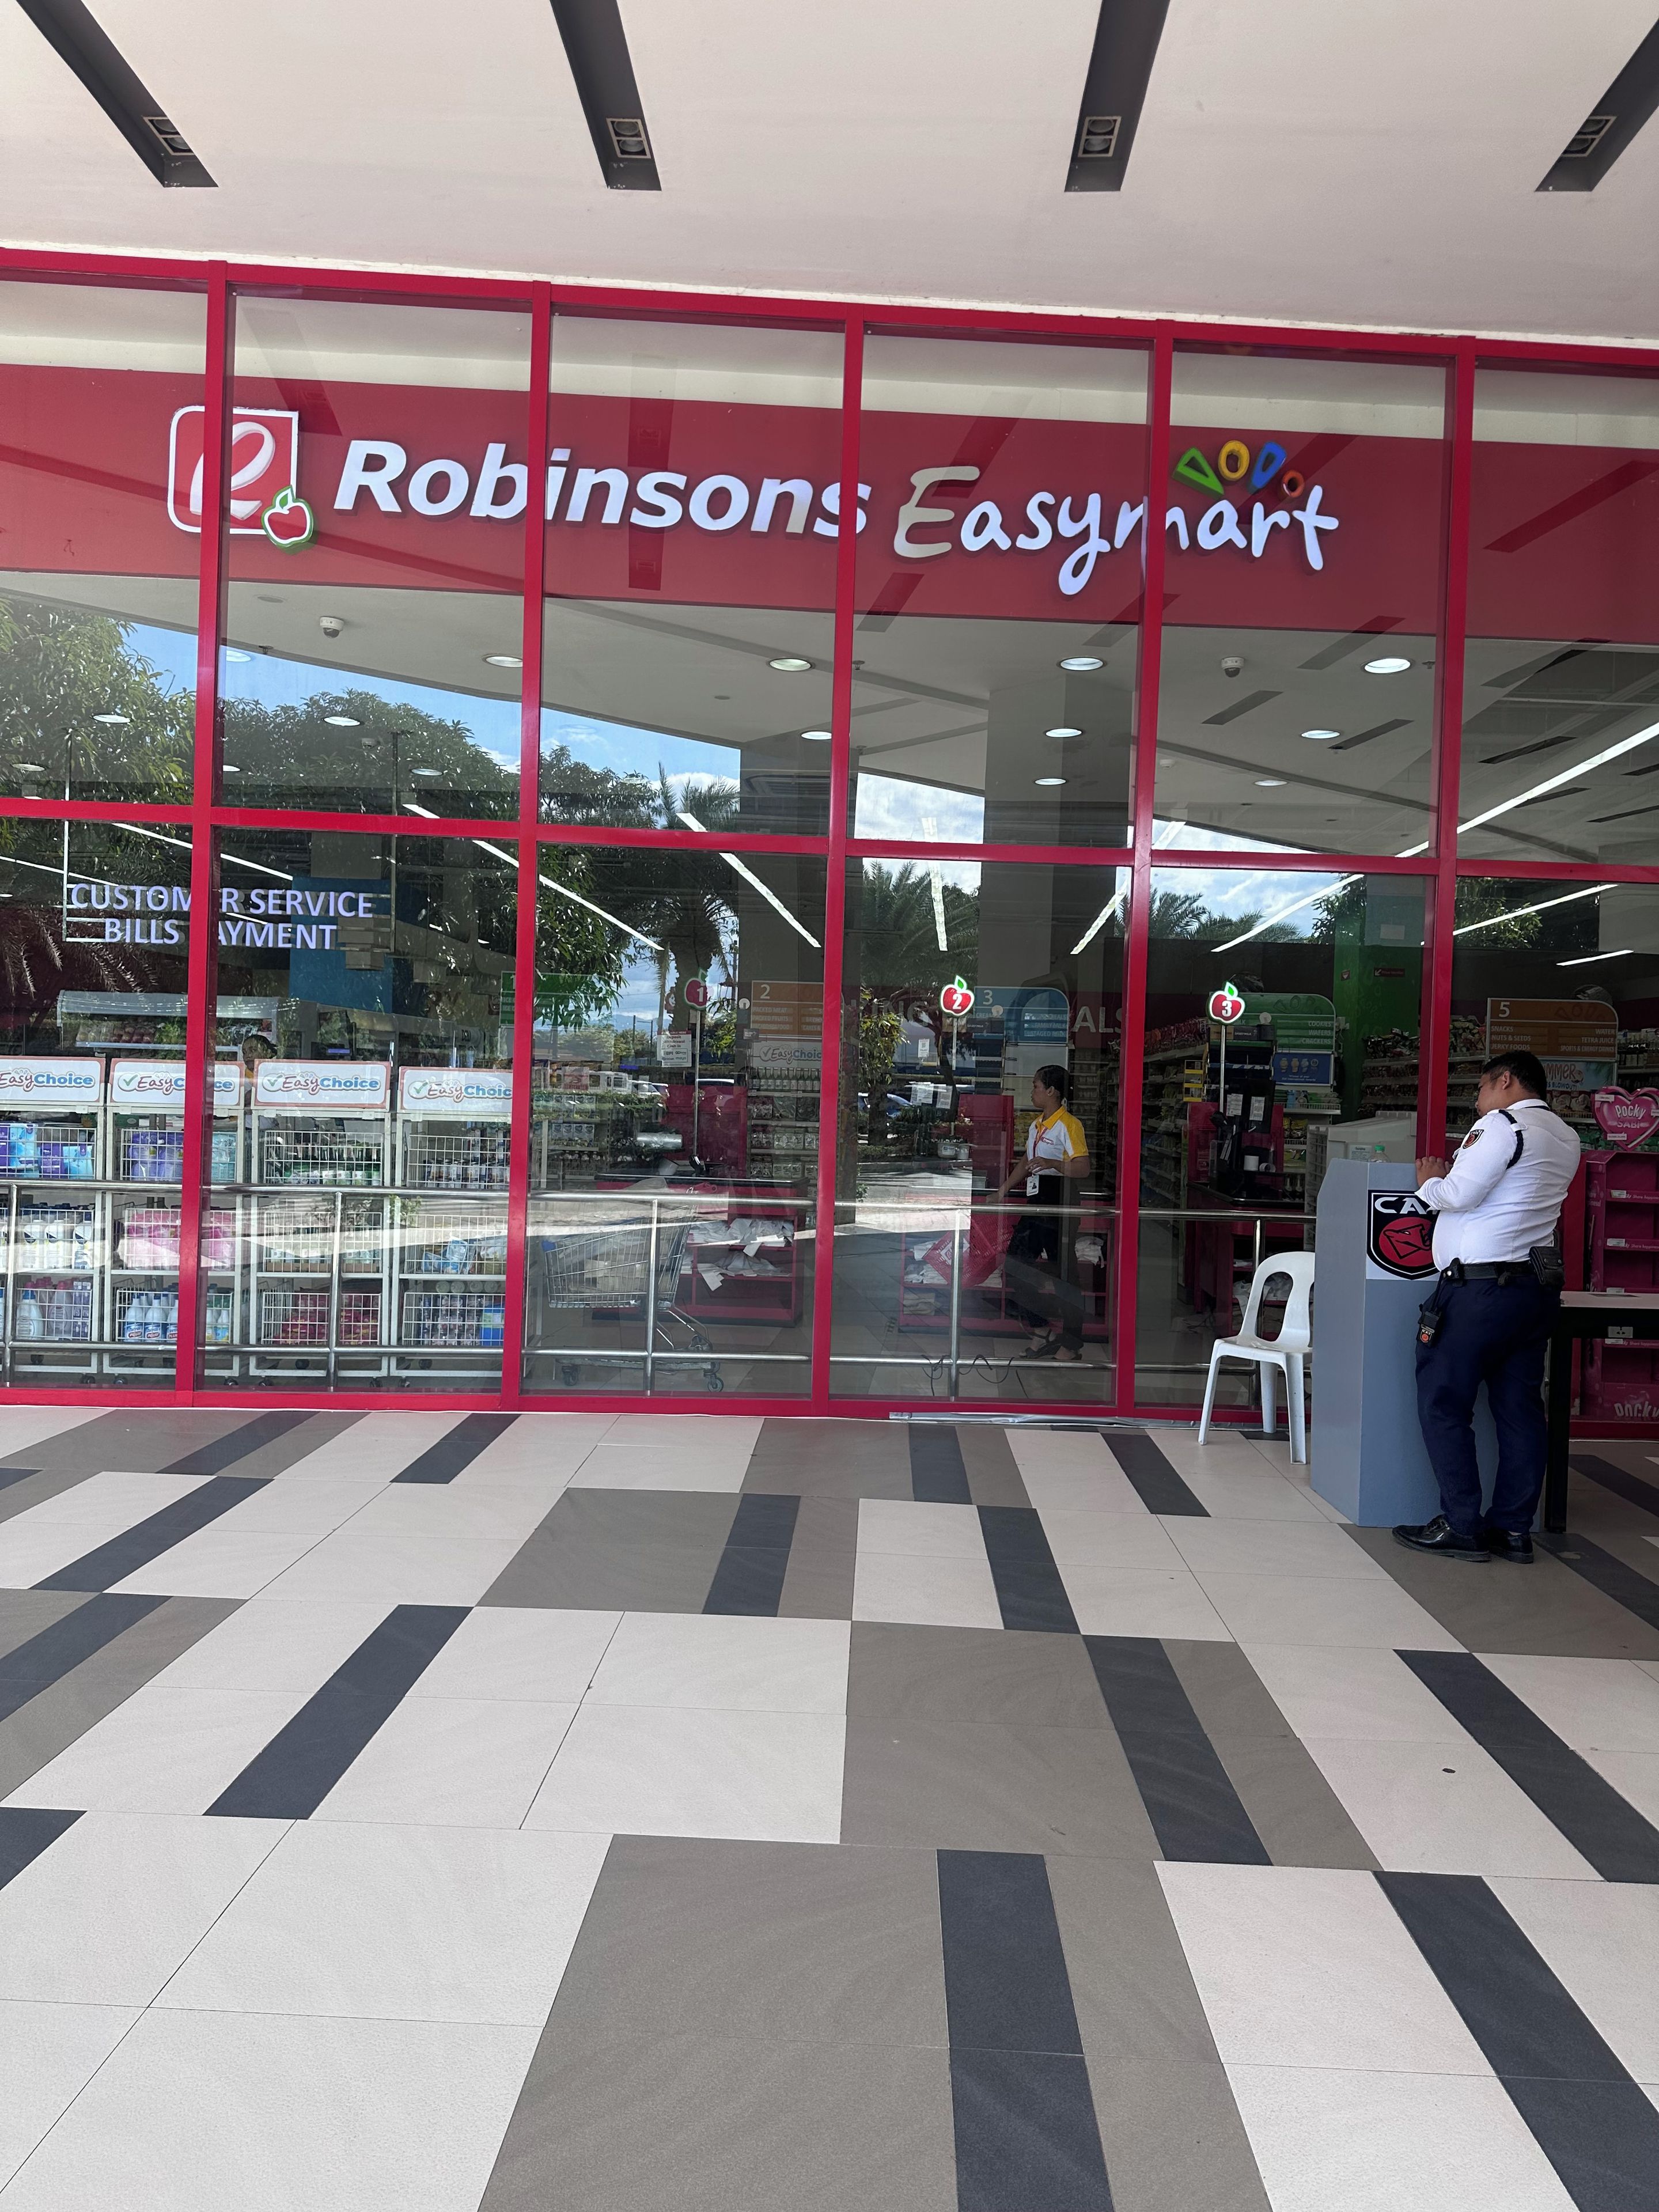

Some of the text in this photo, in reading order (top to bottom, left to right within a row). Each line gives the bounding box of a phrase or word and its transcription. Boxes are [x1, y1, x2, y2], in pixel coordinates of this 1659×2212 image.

[332, 438, 1340, 596] Robinsons Easymart
[71, 882, 374, 918] CUSTOMR SERVICE
[105, 918, 338, 950] BILLS AYMENT
[696, 987, 704, 1002] 1
[760, 984, 771, 999] 2
[983, 990, 993, 1005] 3
[952, 993, 963, 1010] 2
[1221, 1000, 1233, 1017] 3
[1498, 1001, 1510, 1018] 5
[771, 1048, 822, 1062] EasyChoic
[0, 1072, 94, 1092] EasyChoice
[138, 1075, 233, 1095] EasyCce
[282, 1075, 379, 1094] EasyChoice
[427, 1084, 512, 1101] EasyChoic
[1374, 1196, 1438, 1214] CA
